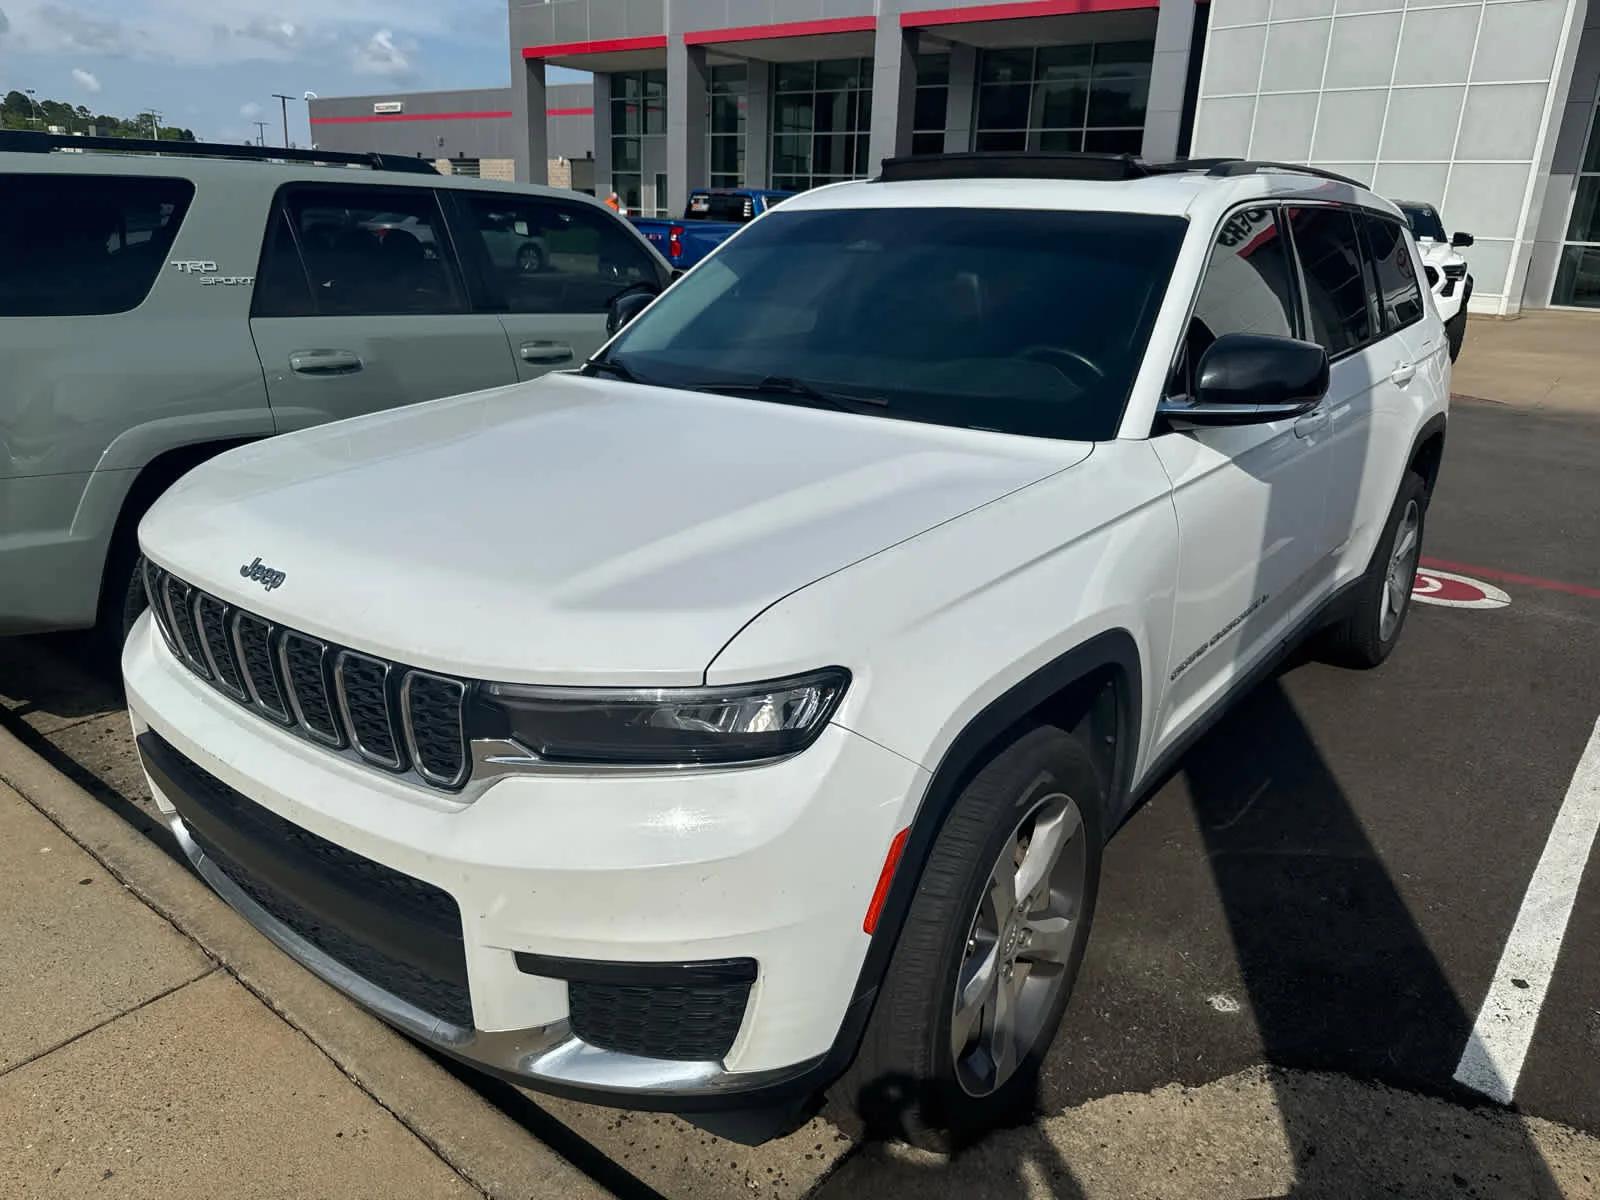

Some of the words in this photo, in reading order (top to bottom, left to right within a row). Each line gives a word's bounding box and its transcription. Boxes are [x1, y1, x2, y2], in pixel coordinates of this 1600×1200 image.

[170, 260, 218, 274] TRD
[200, 276, 256, 286] SPORT
[239, 556, 286, 592] Jeep
